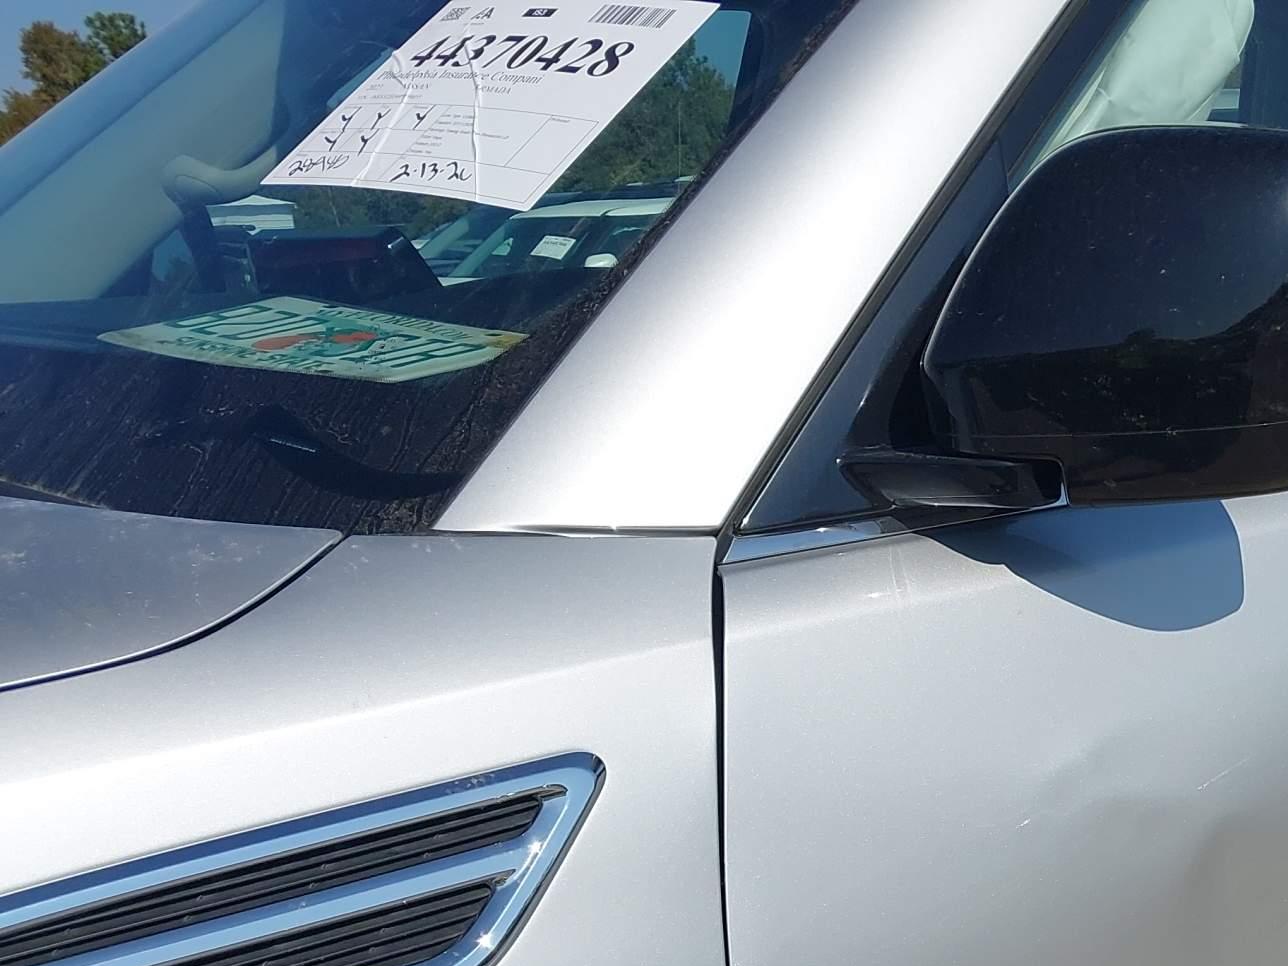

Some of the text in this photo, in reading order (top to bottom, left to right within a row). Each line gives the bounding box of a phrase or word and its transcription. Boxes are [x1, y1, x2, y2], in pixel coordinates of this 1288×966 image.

[409, 34, 635, 78] 44370428
[174, 336, 337, 371] SUNSHINE STATE
